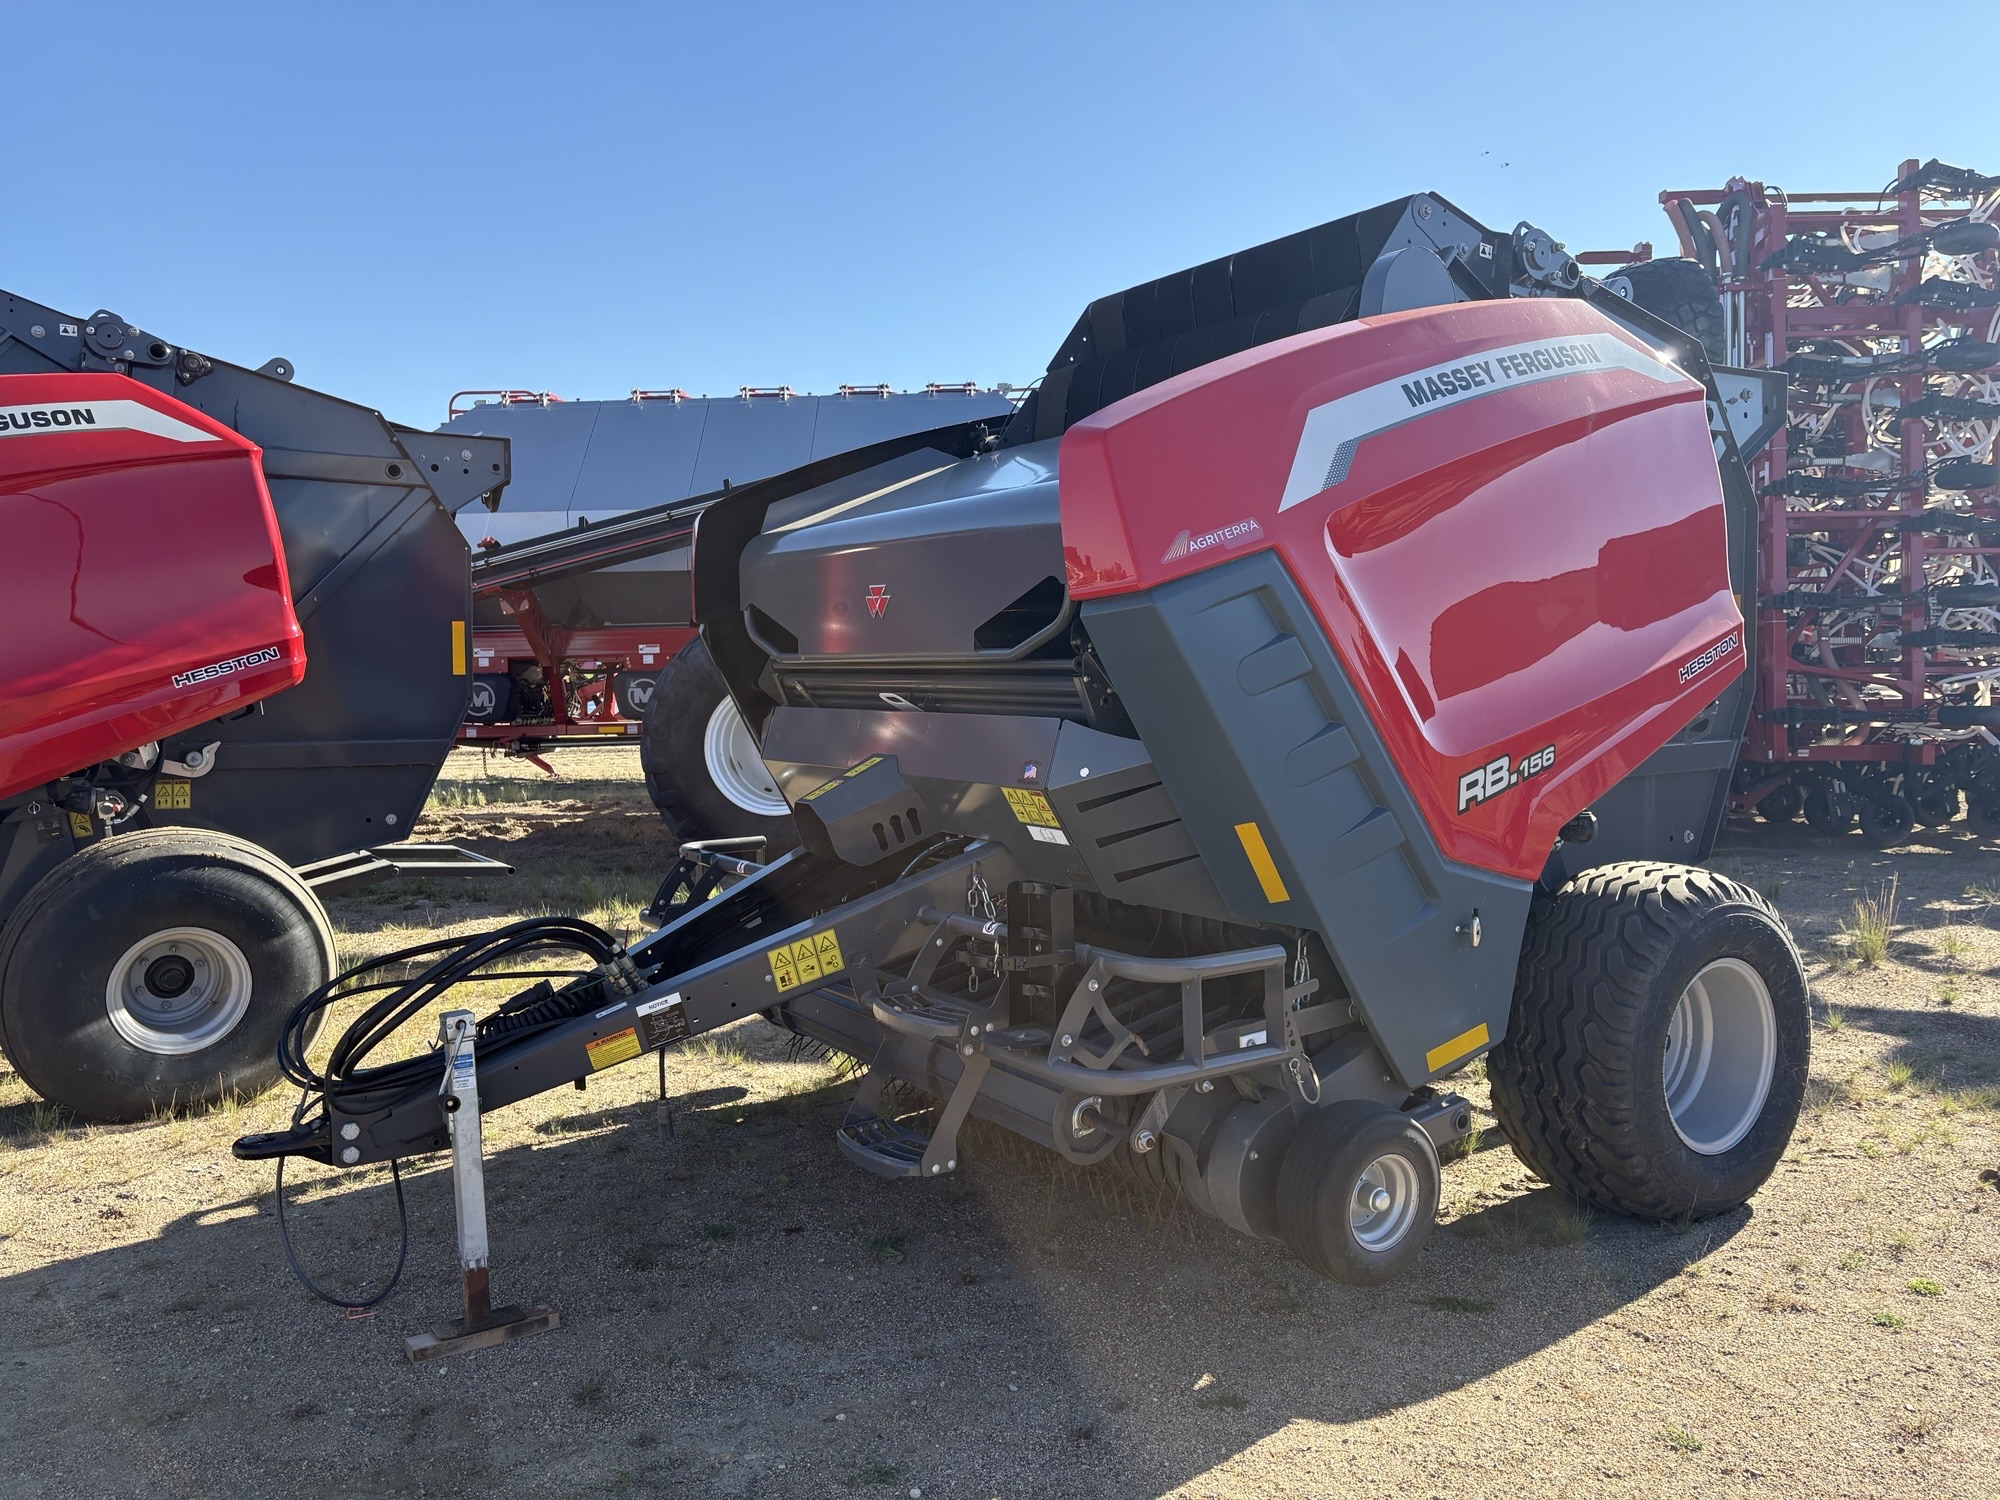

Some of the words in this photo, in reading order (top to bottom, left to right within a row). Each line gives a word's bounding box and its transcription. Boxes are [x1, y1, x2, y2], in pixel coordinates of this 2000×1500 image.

[1401, 361, 1496, 408] MASSEY
[1496, 343, 1601, 380] FERGUSON
[1190, 519, 1260, 552] AGRITERRA
[171, 646, 280, 688] HESSTON
[1679, 631, 1738, 684] HESSTON
[648, 999, 669, 1010] NOTICE
[600, 1031, 627, 1044] WARNING
